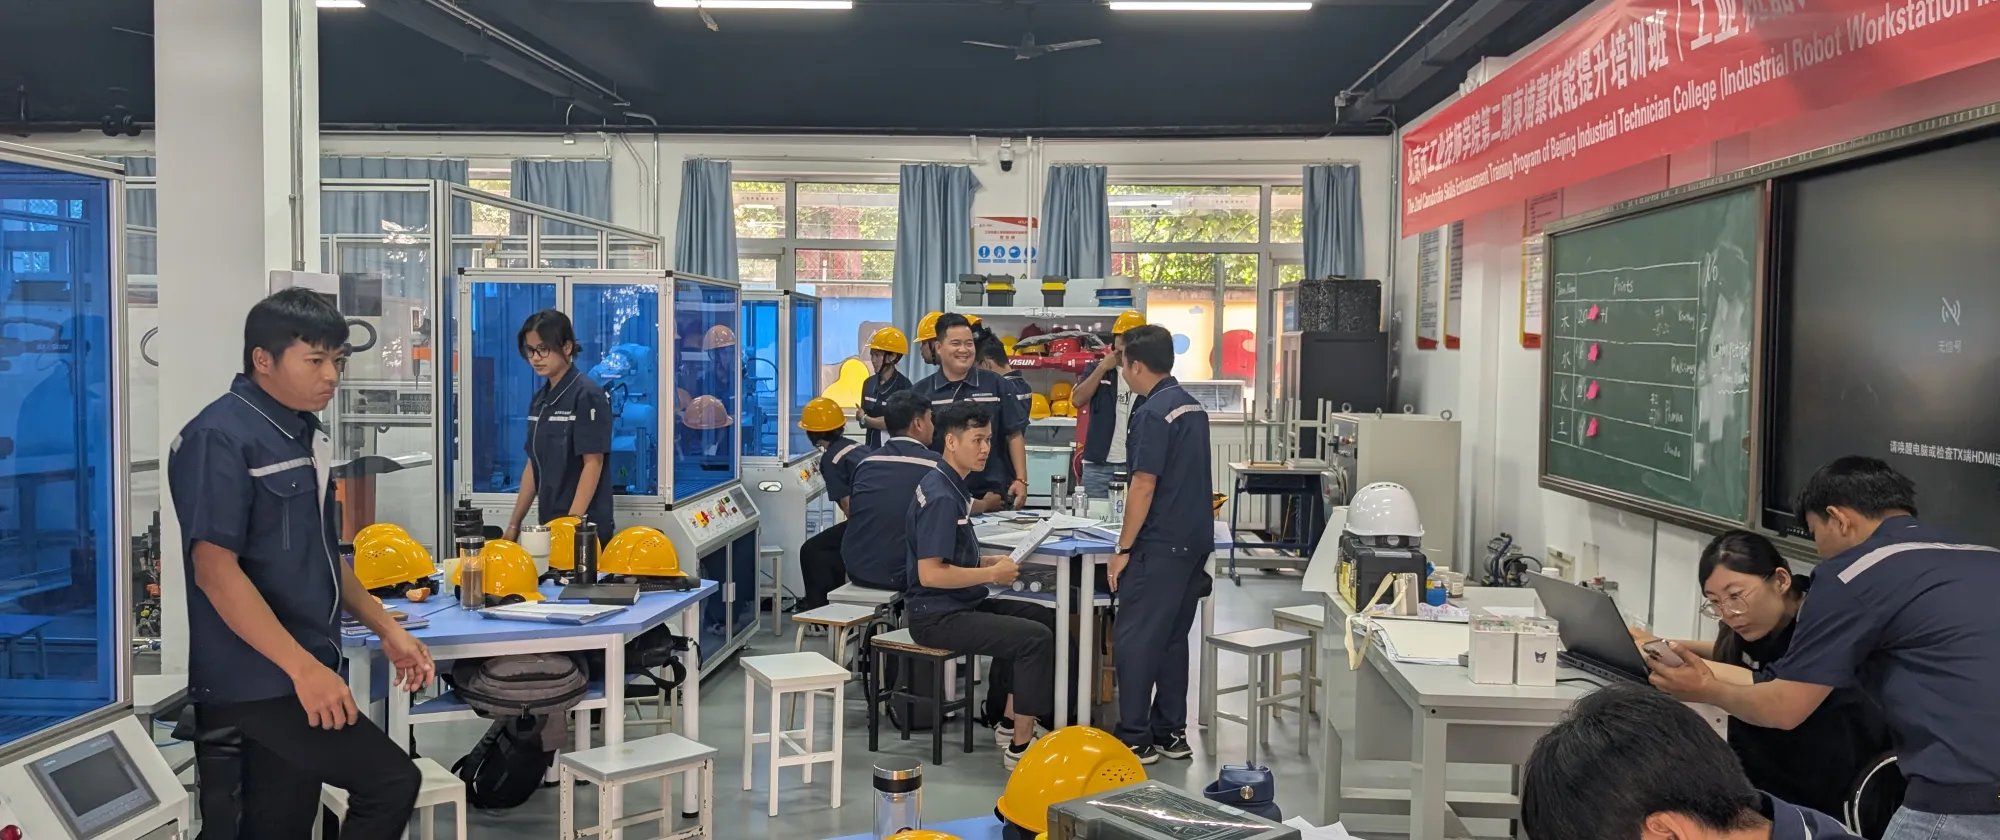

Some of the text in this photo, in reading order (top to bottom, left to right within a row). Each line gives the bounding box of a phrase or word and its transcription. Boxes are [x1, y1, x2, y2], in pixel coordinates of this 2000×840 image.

[1422, 186, 1444, 209] Cambodia
[1443, 180, 1456, 200] Skills
[1455, 168, 1489, 196] Enhancement
[1487, 158, 1513, 183] Training
[1512, 152, 1542, 175] Program
[1542, 138, 1550, 162] of
[1550, 132, 1576, 161] Beijing
[1577, 111, 1617, 149] Industrial
[1617, 94, 1671, 134] Technician
[1673, 79, 1717, 114] College
[1720, 42, 1789, 101] (Industrial
[1793, 26, 1842, 71] Robot
[1612, 276, 1634, 296] Points
[1937, 340, 1962, 354] 无信号
[1556, 415, 1568, 435] 土
